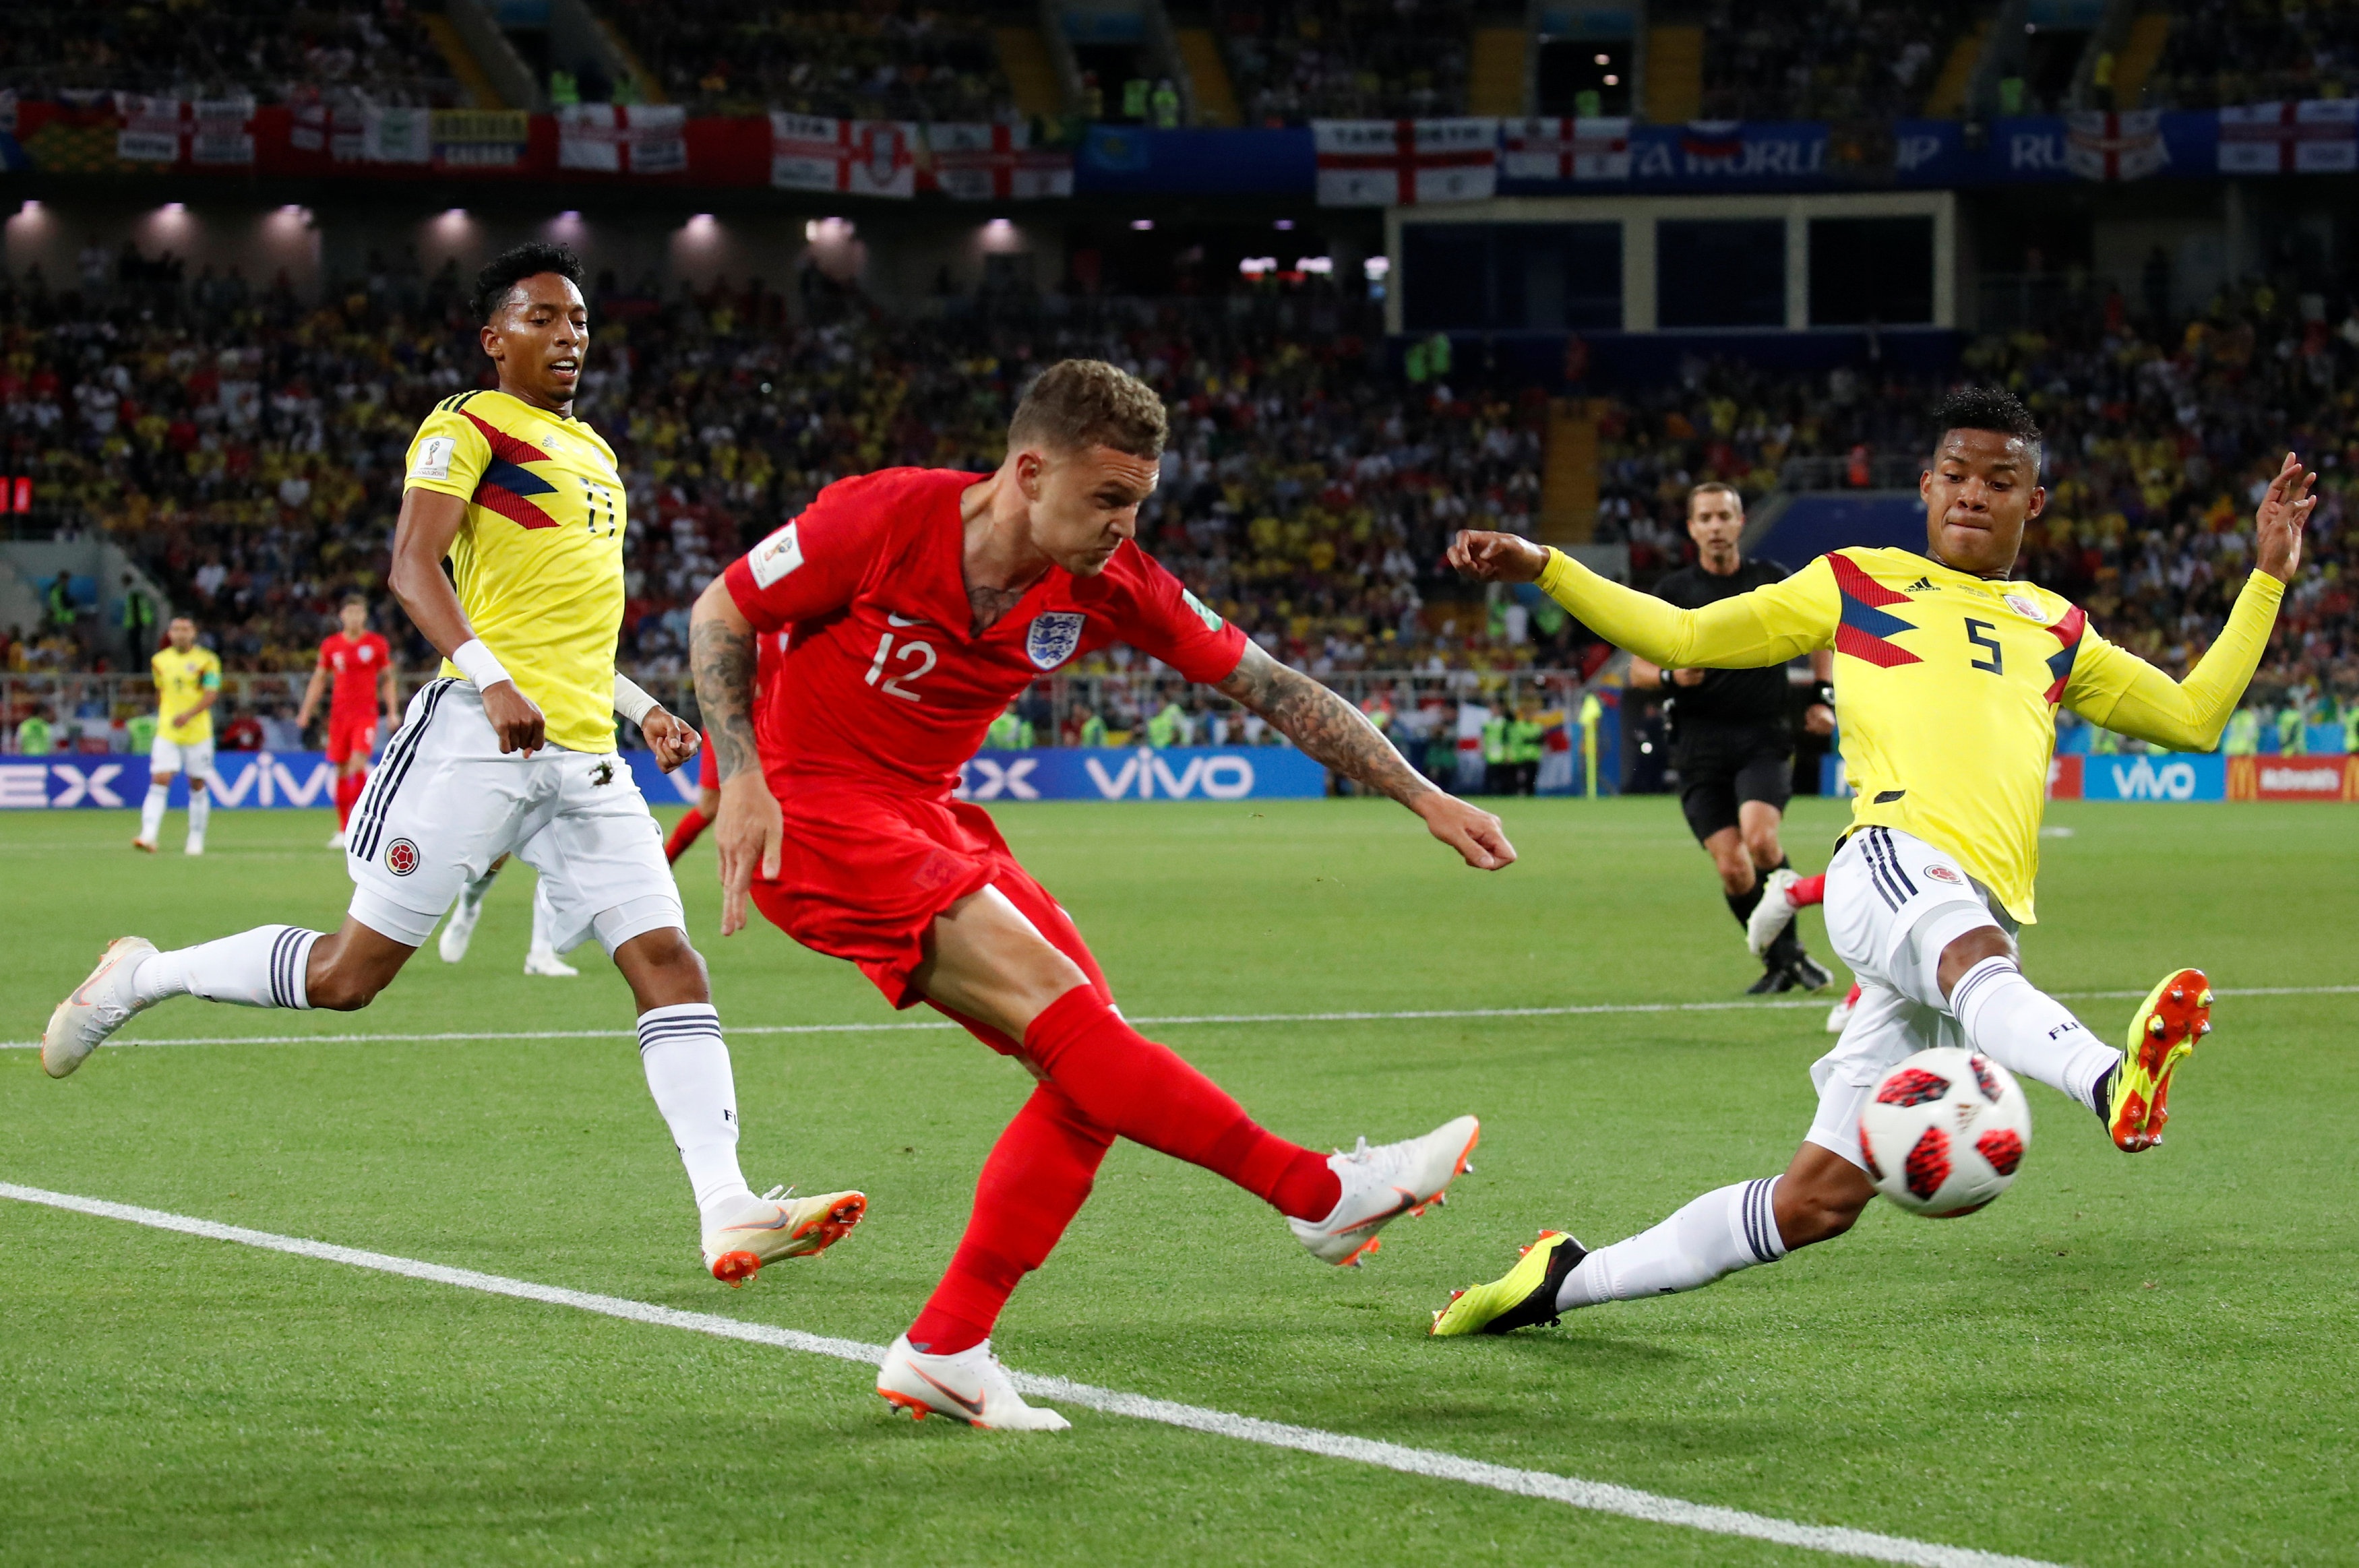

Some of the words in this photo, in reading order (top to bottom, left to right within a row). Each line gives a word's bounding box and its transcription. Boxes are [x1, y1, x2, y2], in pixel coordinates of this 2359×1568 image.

[864, 633, 937, 702] 12
[1964, 617, 2002, 676] 5
[953, 757, 1039, 800] X
